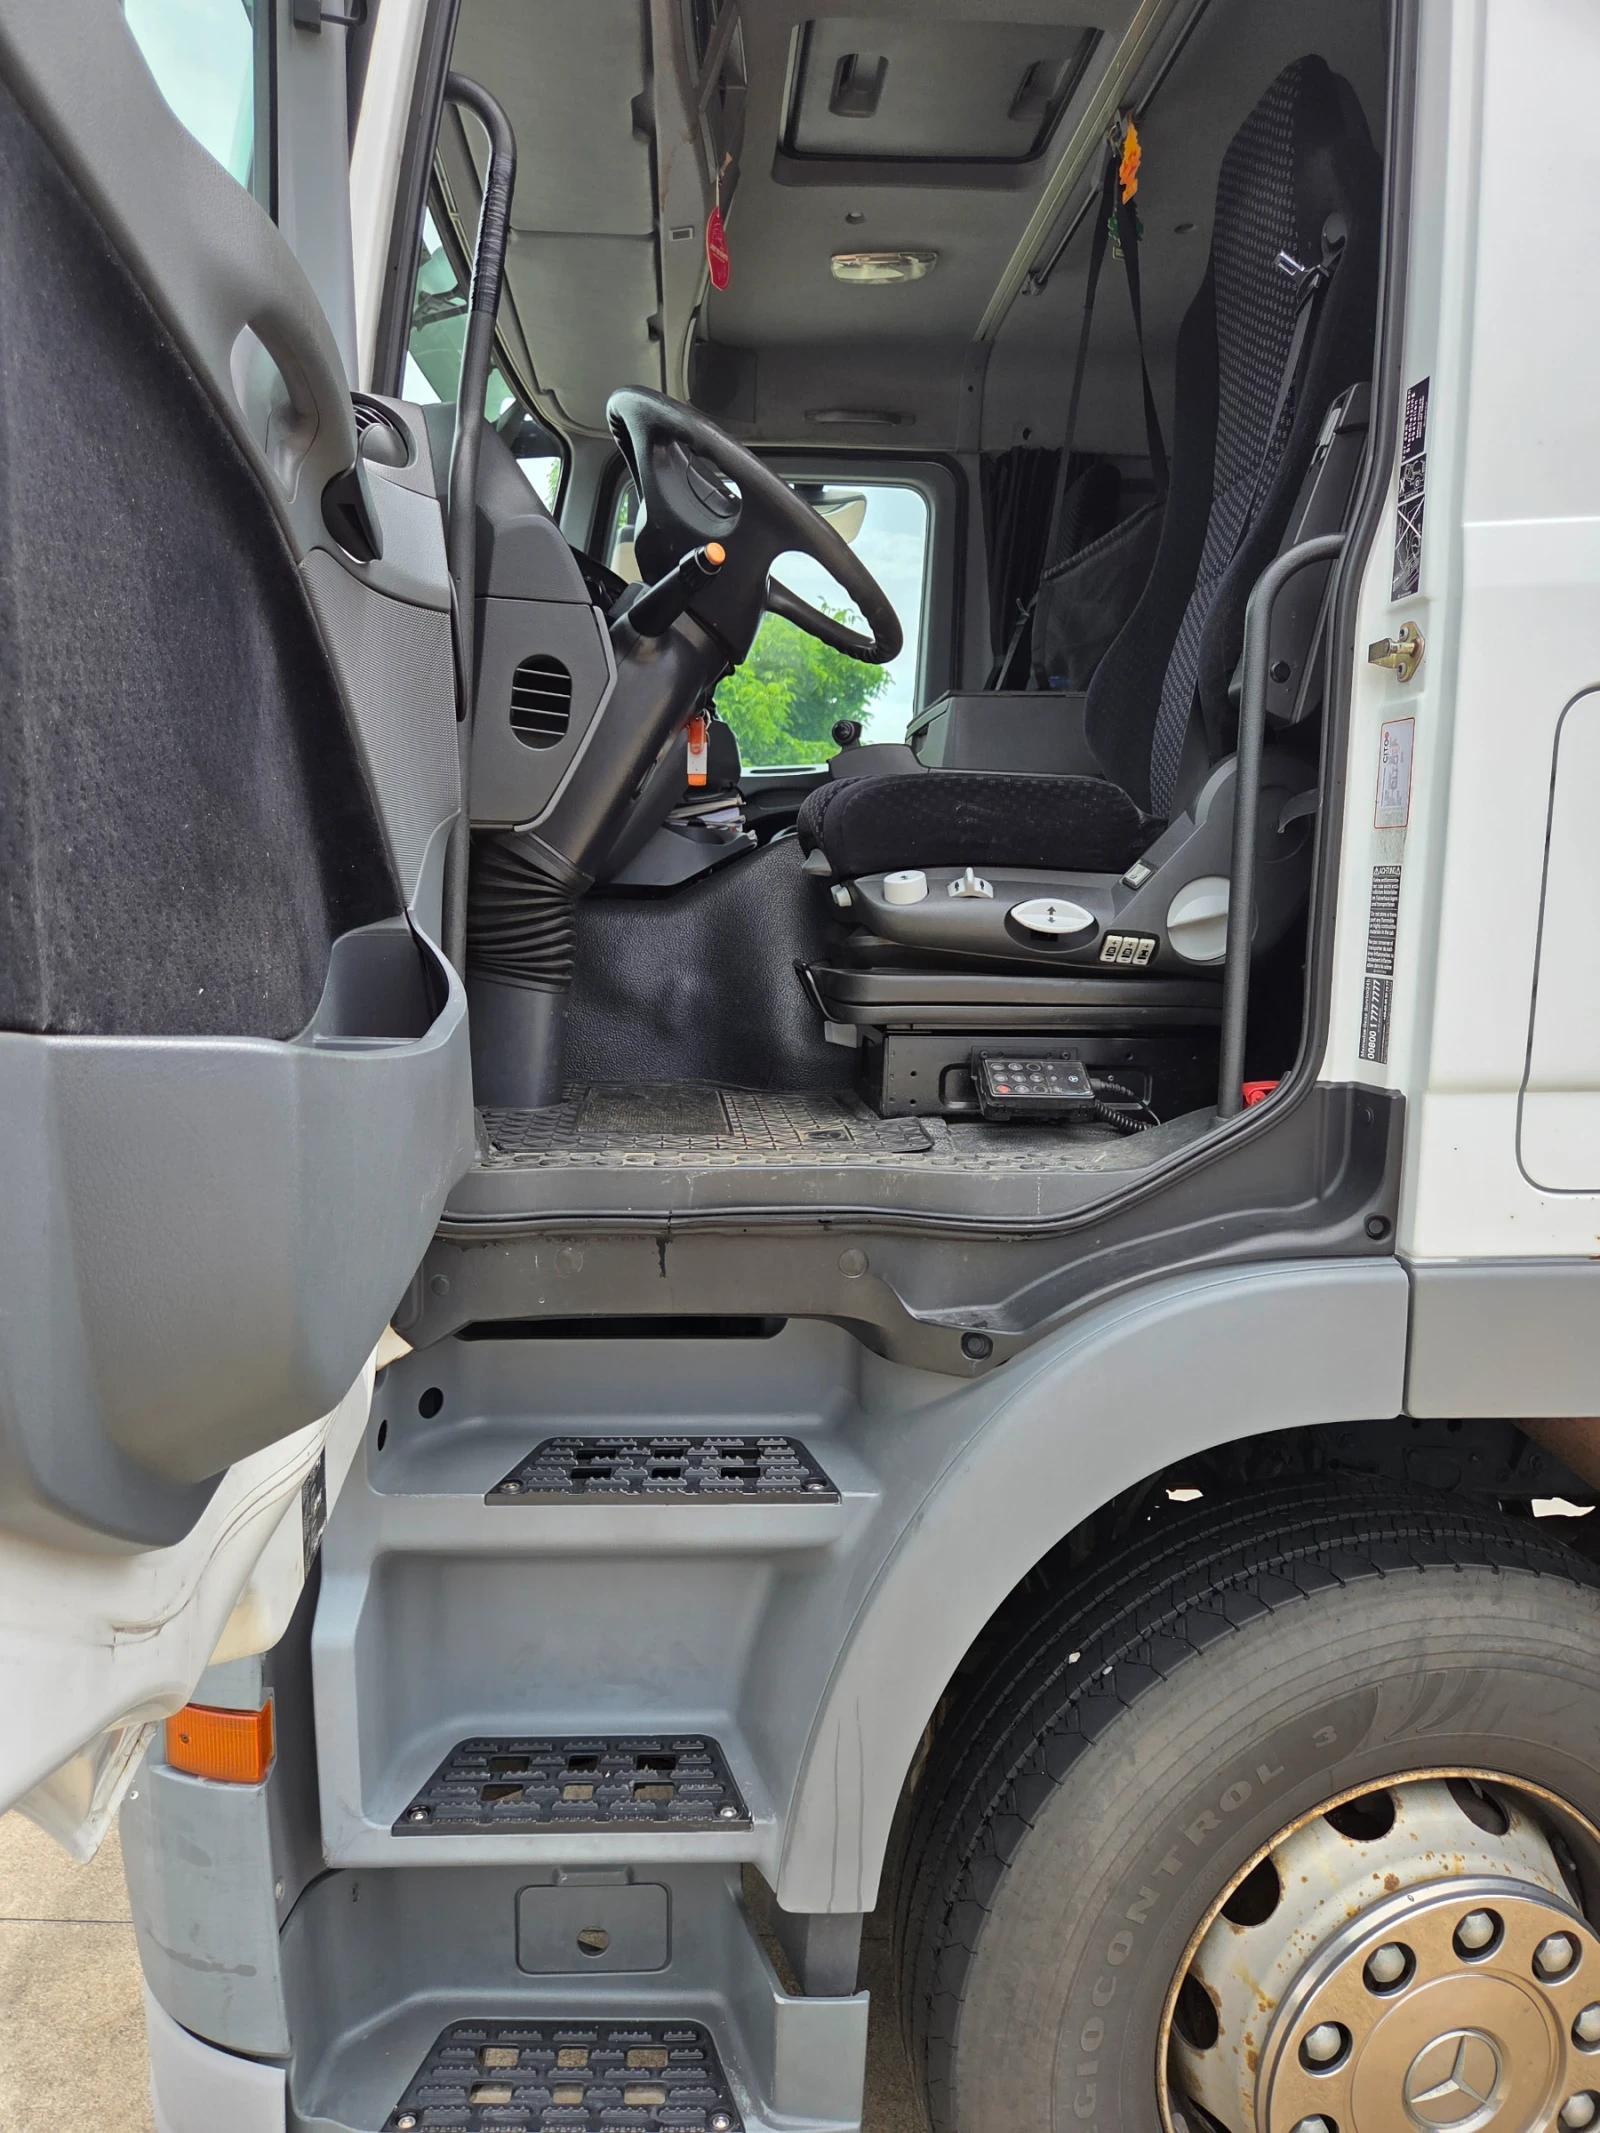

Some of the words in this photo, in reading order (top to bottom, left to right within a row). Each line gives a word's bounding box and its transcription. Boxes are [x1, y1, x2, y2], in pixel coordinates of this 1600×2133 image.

[1372, 979, 1381, 1003] 7777
[1370, 1003, 1379, 1022] 777
[1367, 1031, 1377, 1060] 00800
[1073, 1760, 1286, 2133] GIOCONTROL
[1311, 1724, 1336, 1750] 3
